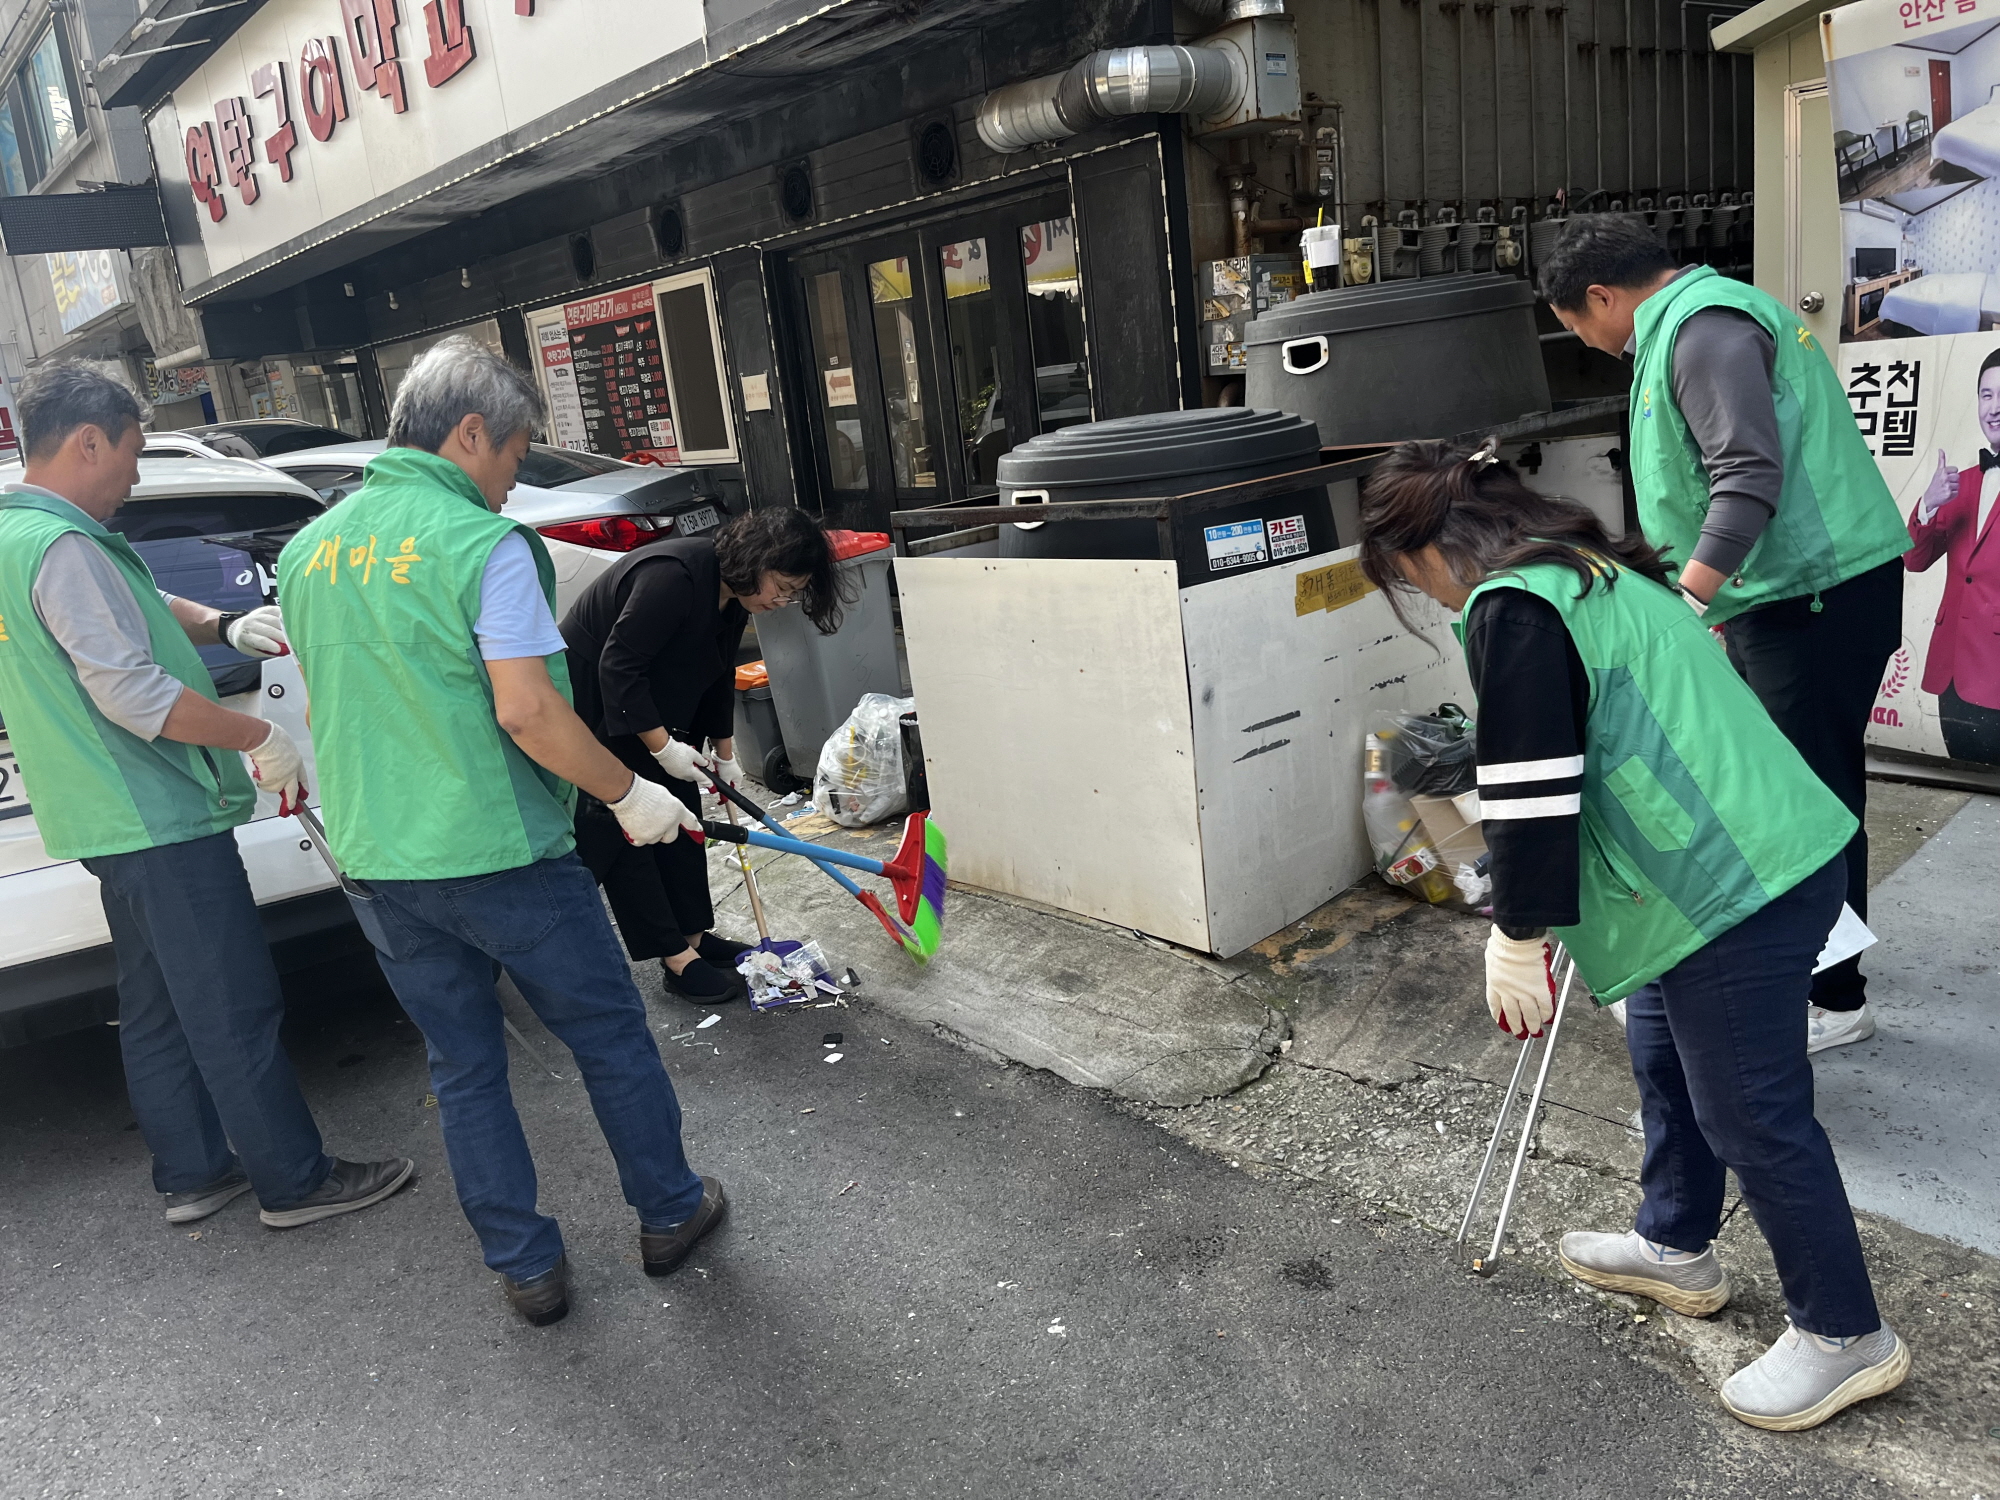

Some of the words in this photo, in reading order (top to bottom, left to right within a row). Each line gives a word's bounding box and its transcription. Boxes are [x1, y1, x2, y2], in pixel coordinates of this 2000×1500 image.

[1899, 0, 1945, 29] 안산
[185, 0, 535, 223] 연탄구이막고
[567, 298, 615, 326] 연탄구이막고기
[614, 302, 628, 315] MENU
[646, 339, 657, 350] 5,000
[648, 354, 660, 366] 5,000
[651, 371, 663, 382] 5,000
[1847, 360, 1921, 409] 추천
[659, 420, 671, 431] 2,000
[663, 434, 673, 445] 1,000
[697, 509, 716, 527] 8977
[1269, 519, 1297, 535] 카드
[304, 534, 422, 585] 새마을
